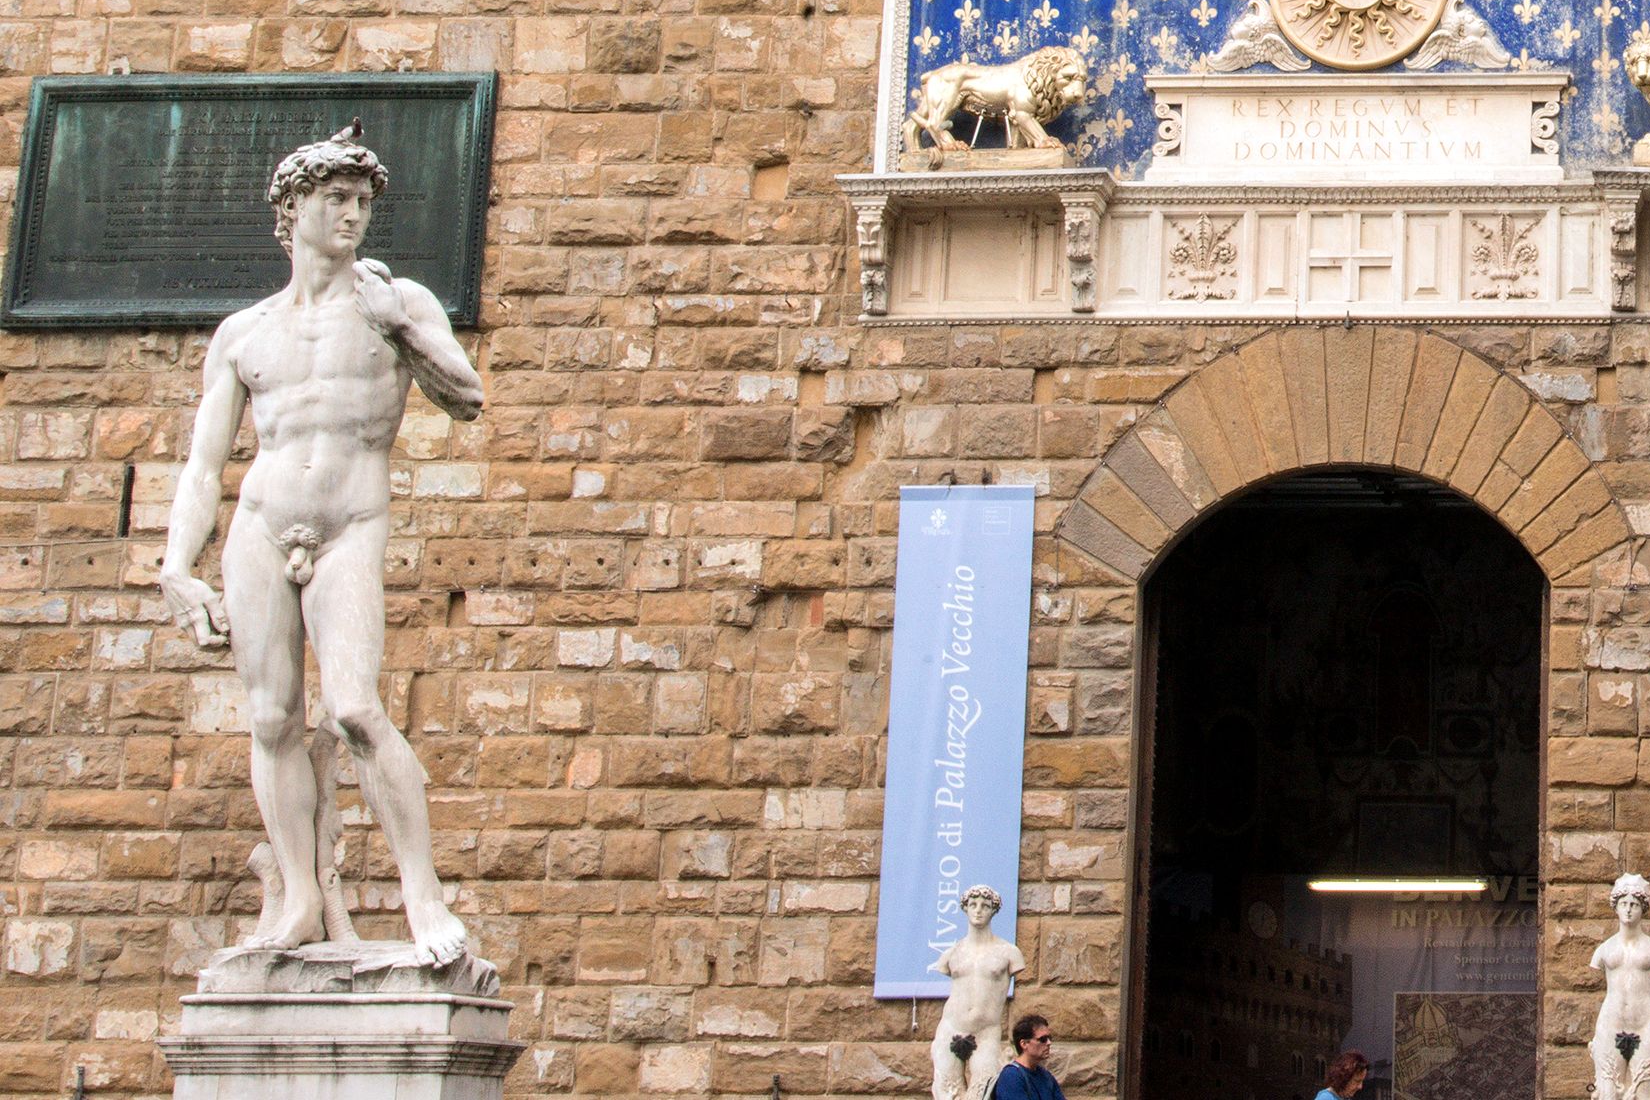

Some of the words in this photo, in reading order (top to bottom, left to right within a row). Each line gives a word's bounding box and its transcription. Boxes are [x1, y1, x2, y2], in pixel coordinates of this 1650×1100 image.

[1232, 98, 1294, 118] REX
[1309, 98, 1421, 117] REGVM
[1446, 98, 1485, 117] ET
[1280, 120, 1433, 139] DOMINVS
[1234, 141, 1482, 160] DOMINANTIVM
[941, 565, 976, 679] Vecchio
[934, 684, 982, 812] Palazzo
[937, 821, 962, 847] di
[1391, 909, 1417, 928] IN
[1426, 908, 1537, 927] PALAZZO
[1455, 954, 1500, 967] Sponsor
